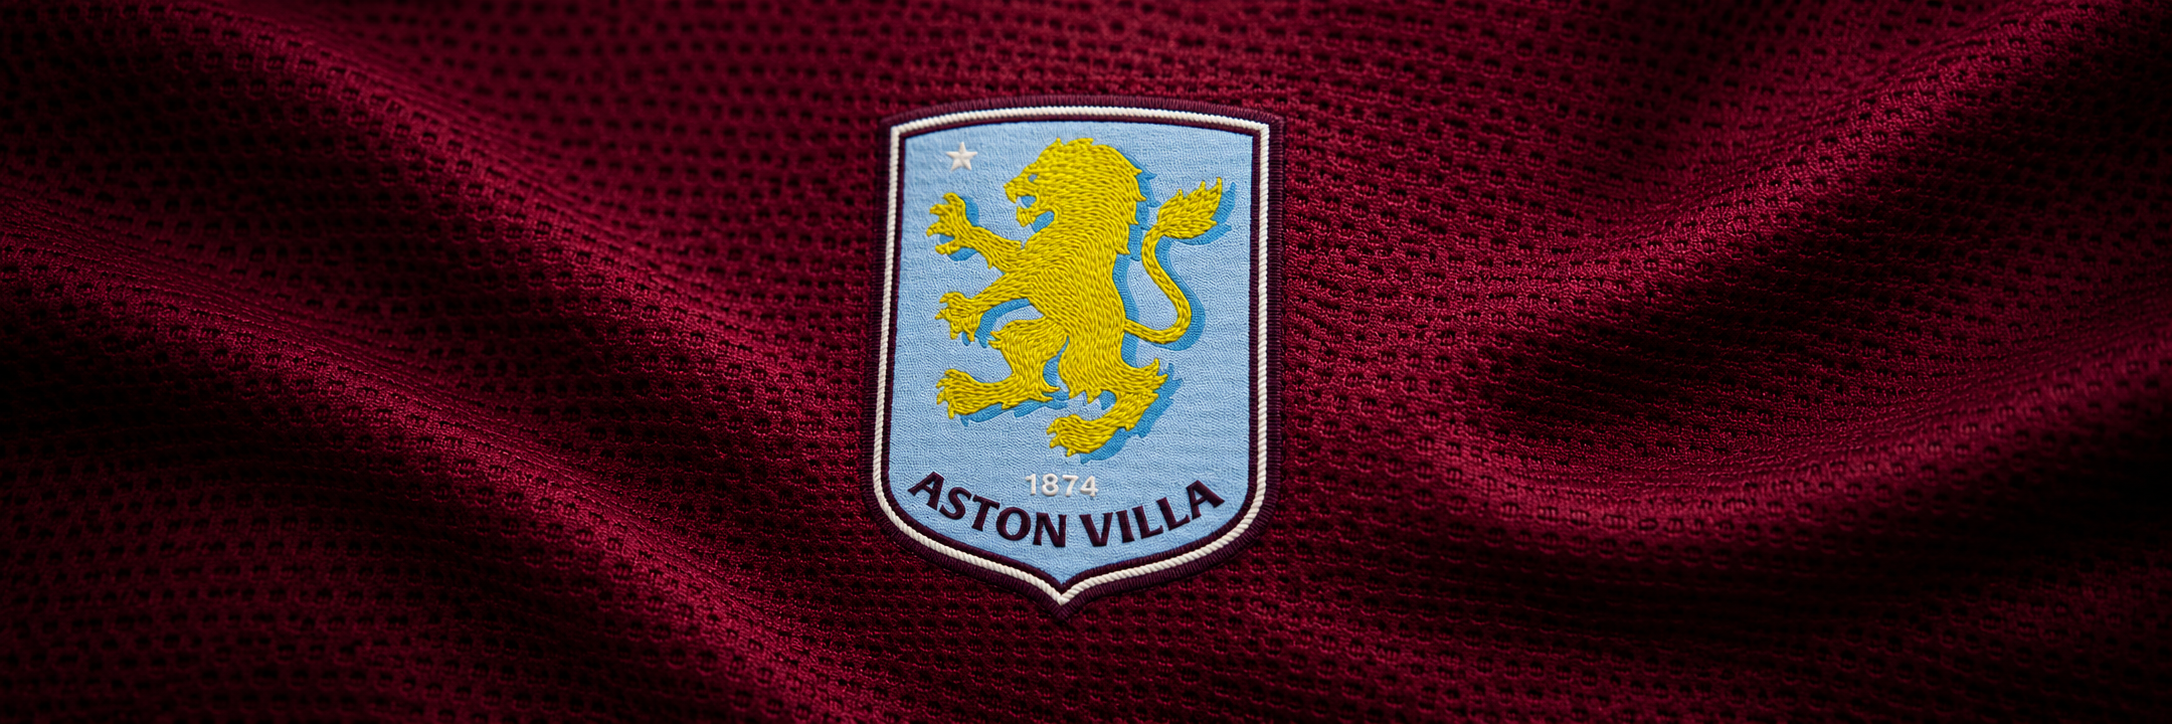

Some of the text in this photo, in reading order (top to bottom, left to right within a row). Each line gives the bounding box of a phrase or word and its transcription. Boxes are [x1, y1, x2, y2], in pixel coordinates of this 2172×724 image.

[907, 471, 1225, 547] ASTON VILLA
[1025, 473, 1098, 497] 1874
